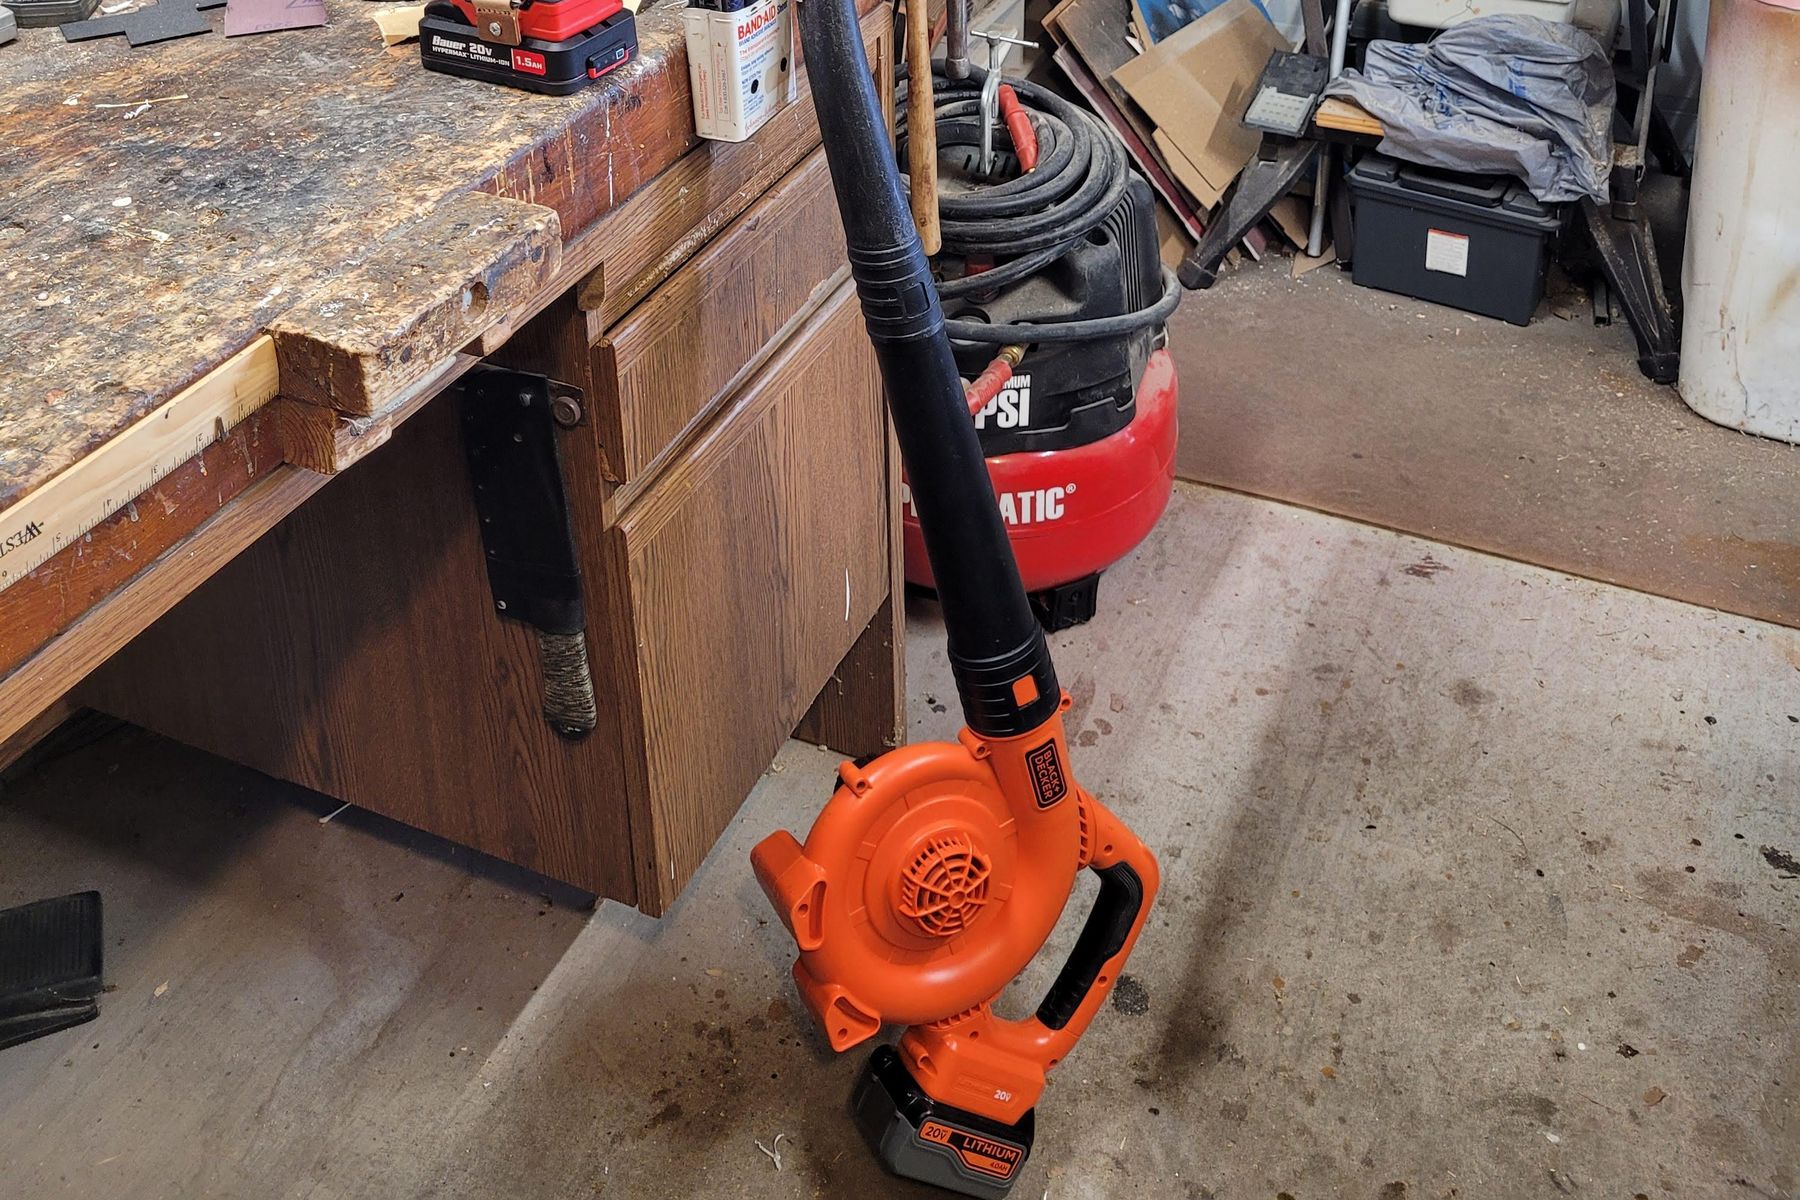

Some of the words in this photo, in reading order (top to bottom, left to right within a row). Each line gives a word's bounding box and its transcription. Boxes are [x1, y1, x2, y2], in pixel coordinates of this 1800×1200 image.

[432, 35, 466, 50] Bauer
[470, 53, 510, 67] LITHIUM-ION
[515, 55, 543, 70] 1.5AH
[974, 388, 1031, 429] PSI
[1034, 755, 1053, 800] DECKER
[962, 1137, 1017, 1162] LITHIUM
